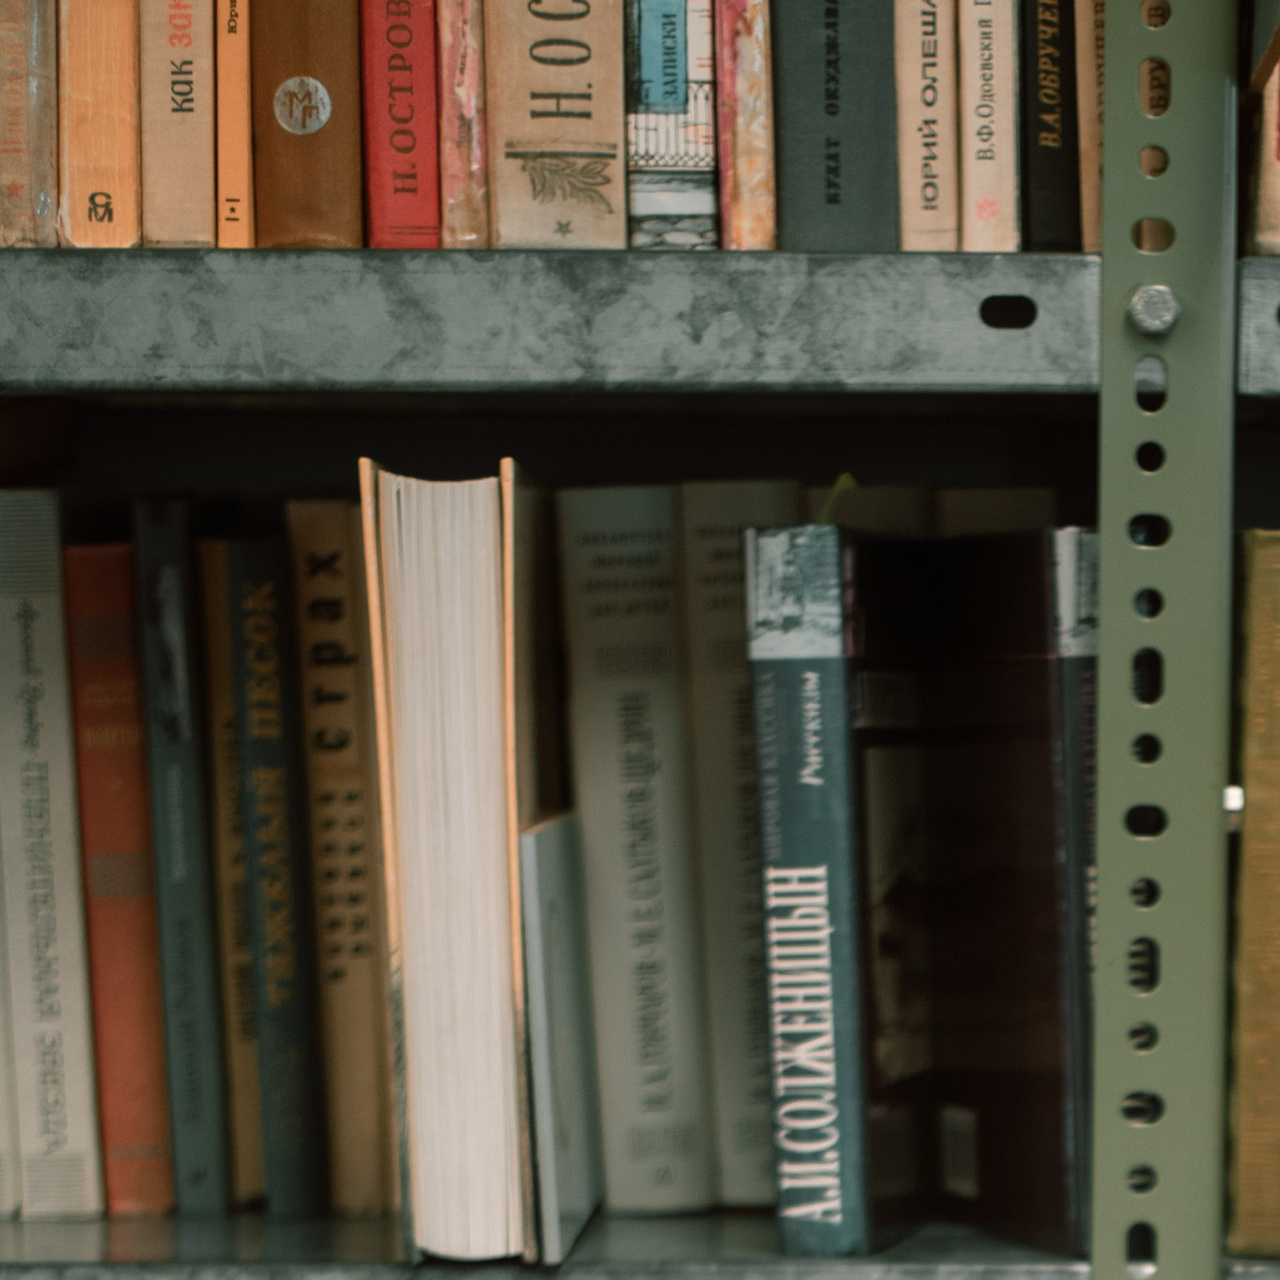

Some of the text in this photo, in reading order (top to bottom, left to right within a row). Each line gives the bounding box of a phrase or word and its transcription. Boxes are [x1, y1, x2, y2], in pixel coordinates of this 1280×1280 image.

[661, 13, 679, 101] ЗАПИСКИ
[824, 136, 842, 205] БУЛАТ
[917, 118, 940, 212] ЮРИЙ
[244, 580, 283, 740] ПЕСОК
